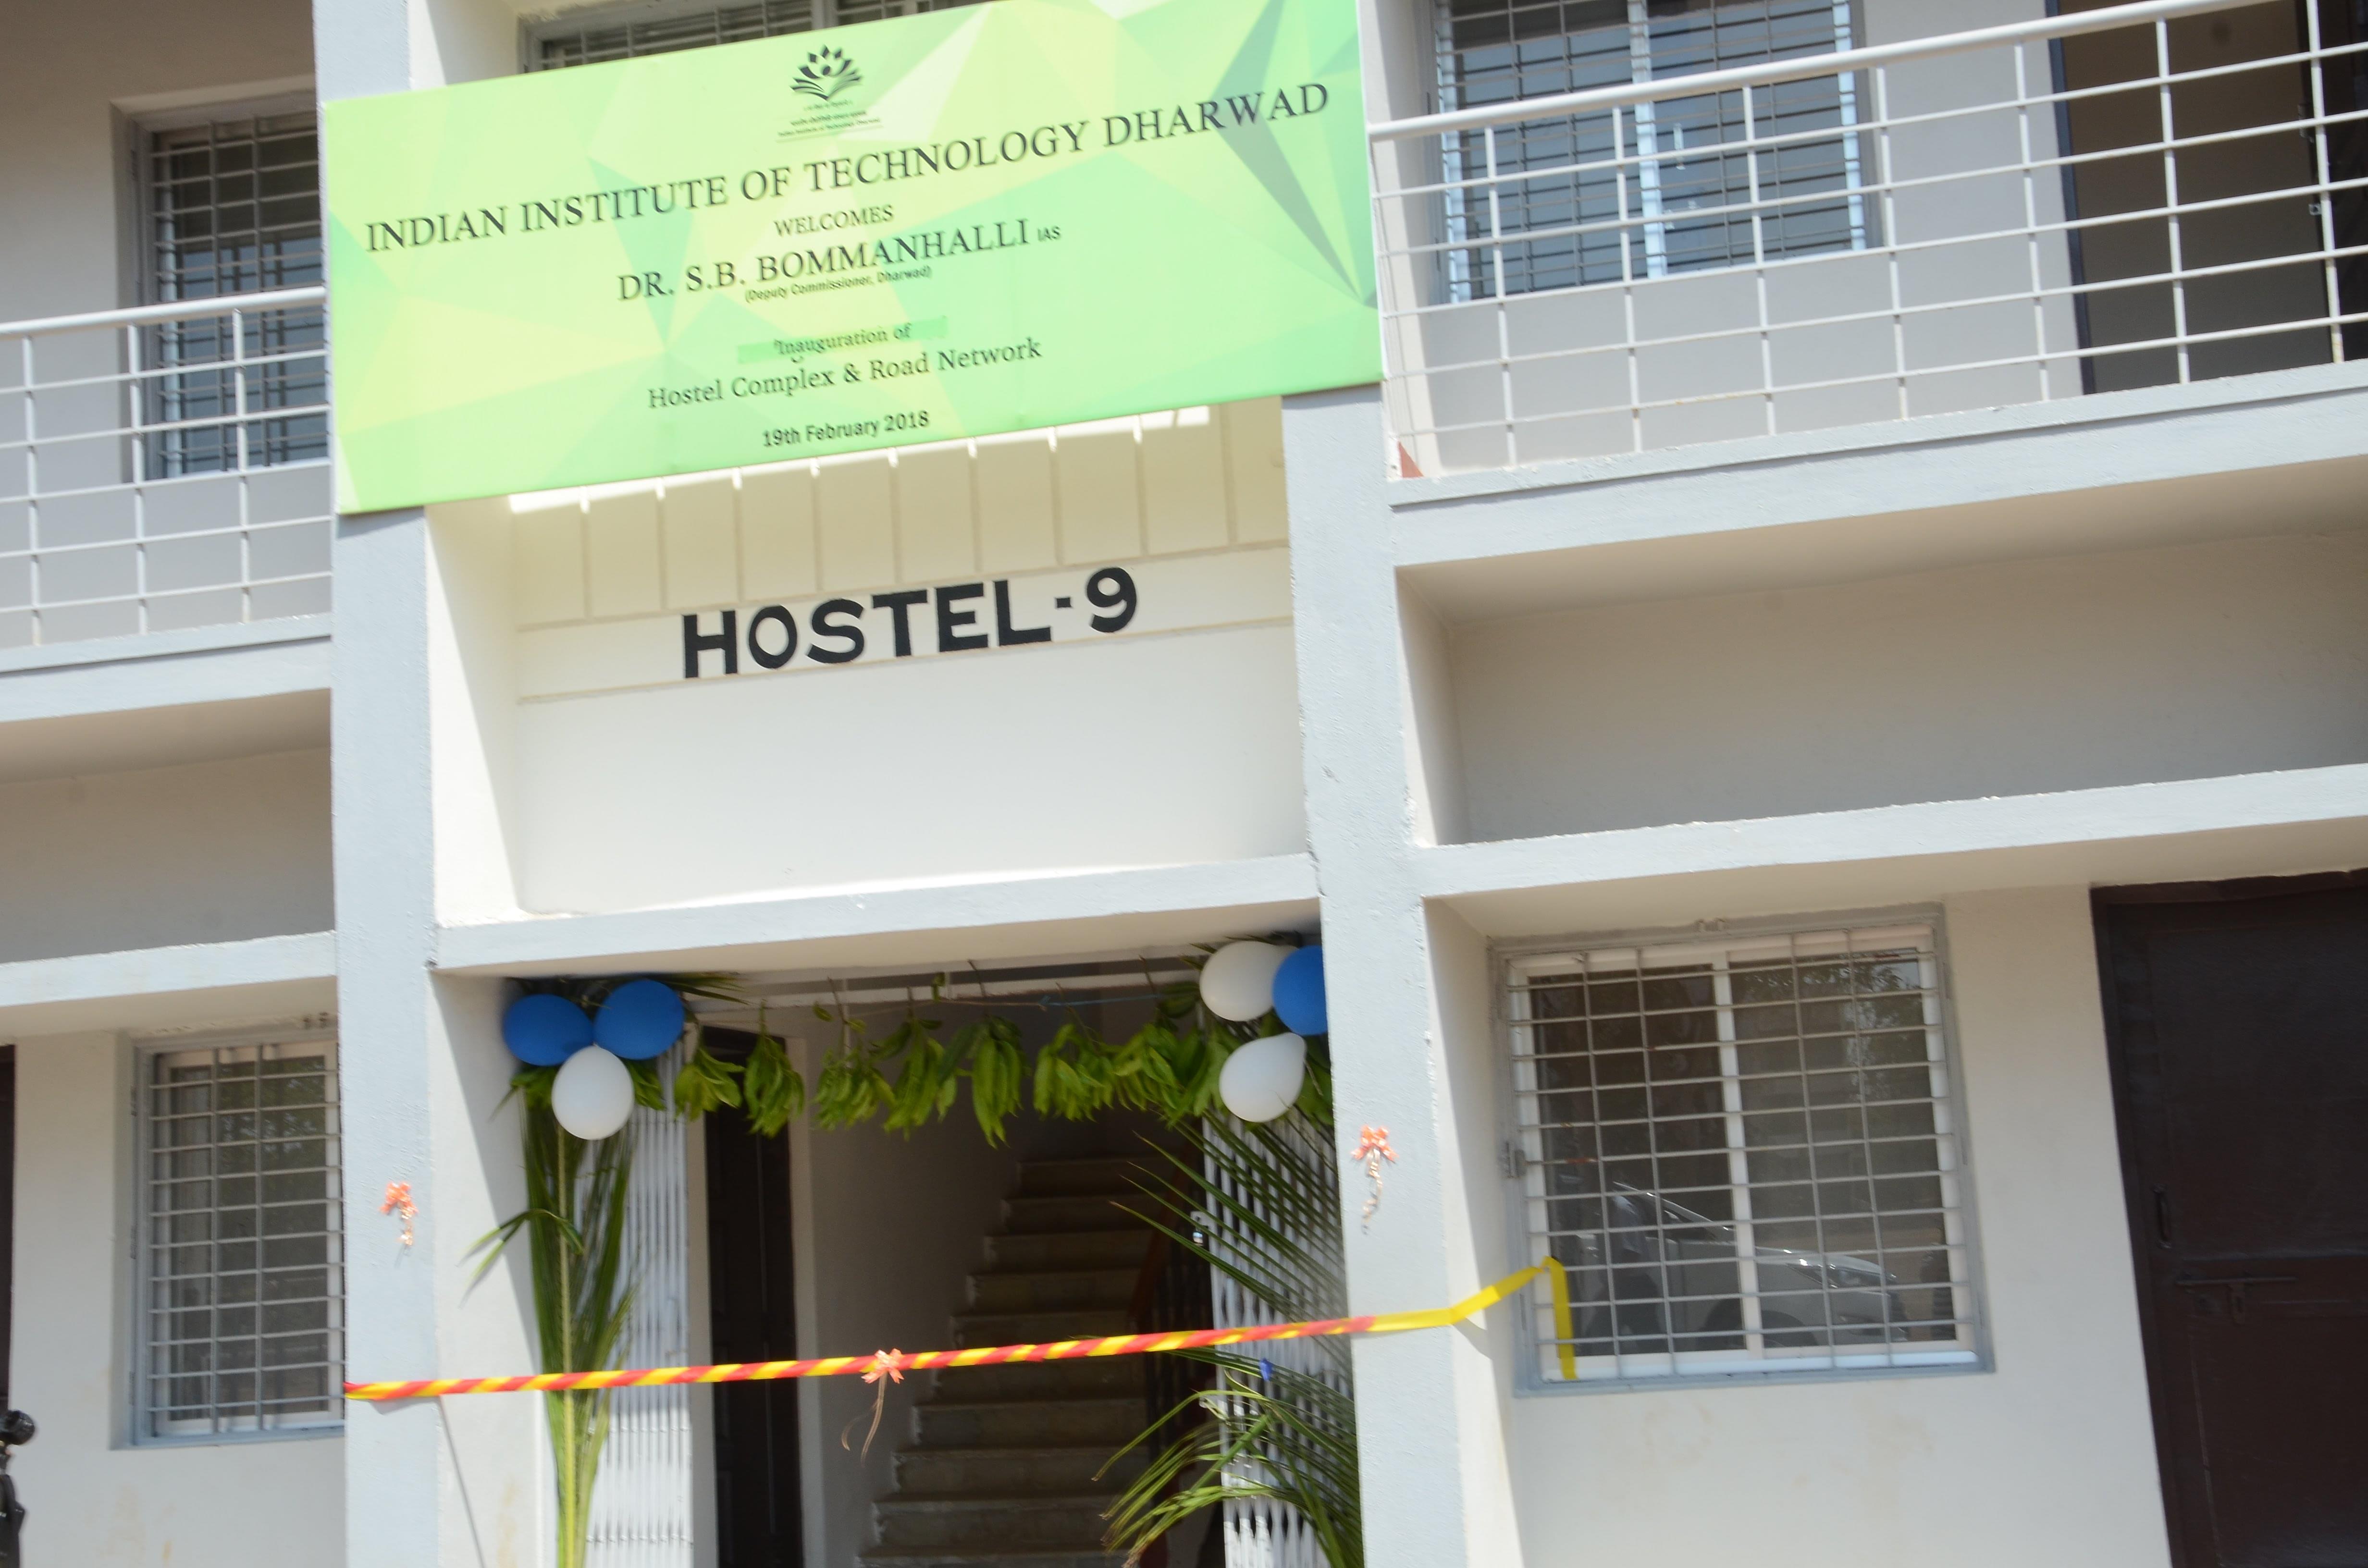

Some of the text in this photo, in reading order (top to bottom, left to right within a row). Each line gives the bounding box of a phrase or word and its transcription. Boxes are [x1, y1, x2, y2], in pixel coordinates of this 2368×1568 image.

[365, 83, 1328, 253] INDIAN INSTITUTE OF TECHNOLOGY DHARWAD
[774, 204, 895, 237] WELCOMES
[617, 218, 1062, 301] DR. S.B. BOMMANHALLI IAS
[745, 286, 787, 304] (Deputy
[876, 265, 932, 283] Dharwad)
[893, 322, 912, 341] of
[648, 336, 1043, 408] Hostel Complex & Road Network
[763, 409, 931, 448] 19th February 2018
